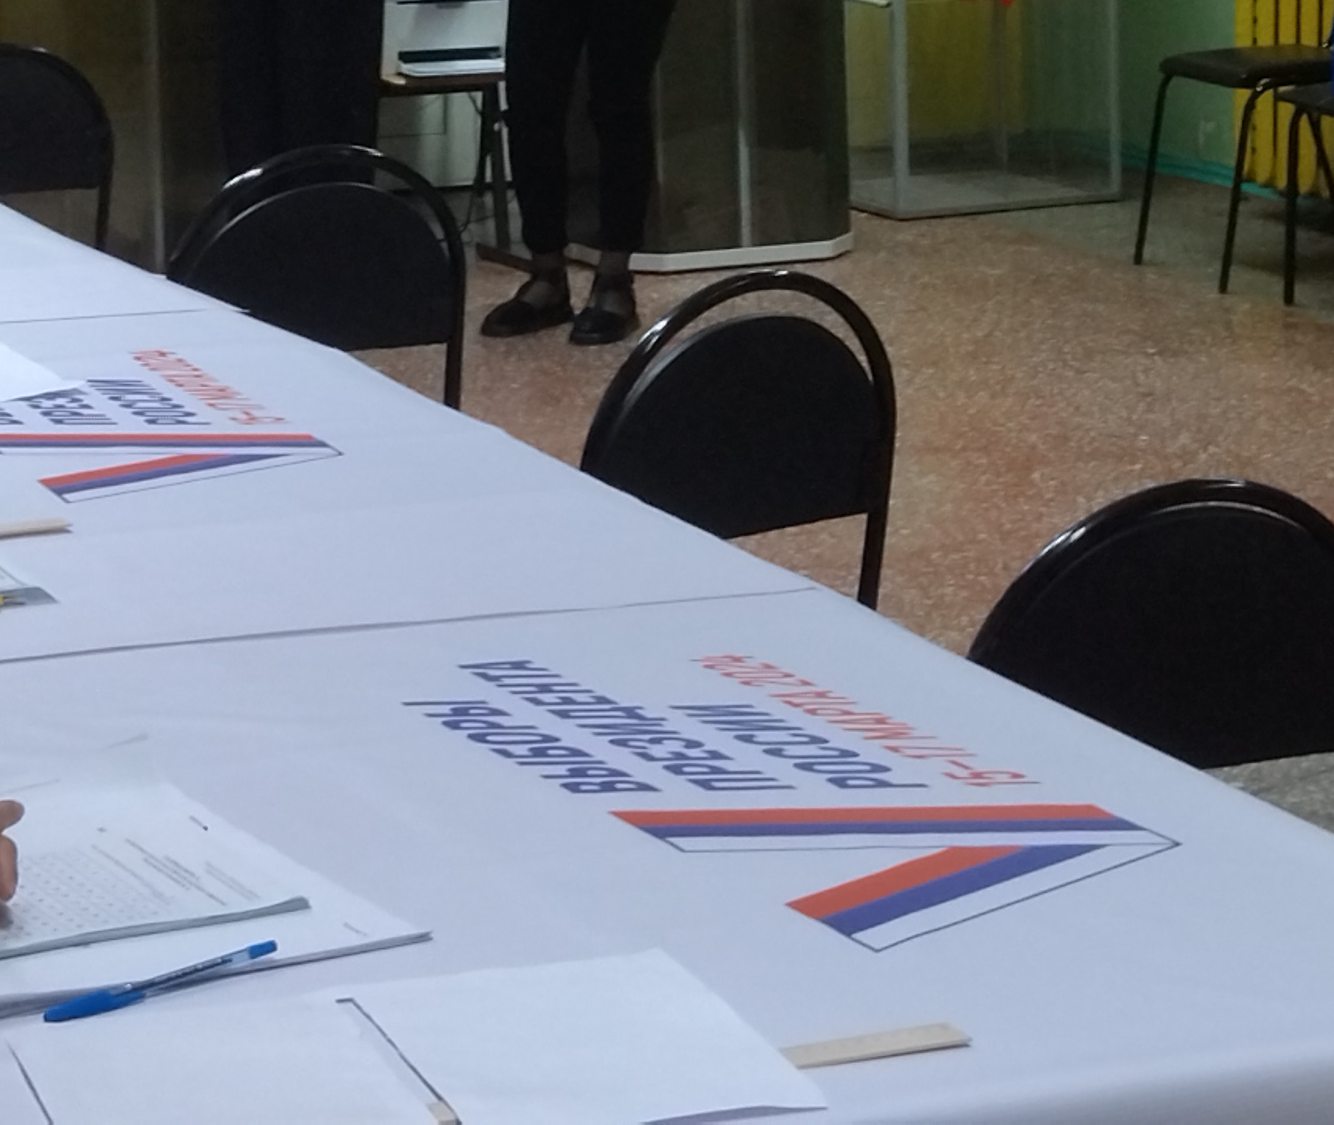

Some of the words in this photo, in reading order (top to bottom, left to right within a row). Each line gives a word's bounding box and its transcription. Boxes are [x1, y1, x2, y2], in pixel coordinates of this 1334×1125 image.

[690, 653, 816, 687] 2024
[402, 700, 662, 794] ВЫБОРЫ
[457, 660, 798, 792] ПРЕЗИДЕНТА
[668, 704, 929, 790] РОССИИ
[768, 689, 937, 740] МАРТА
